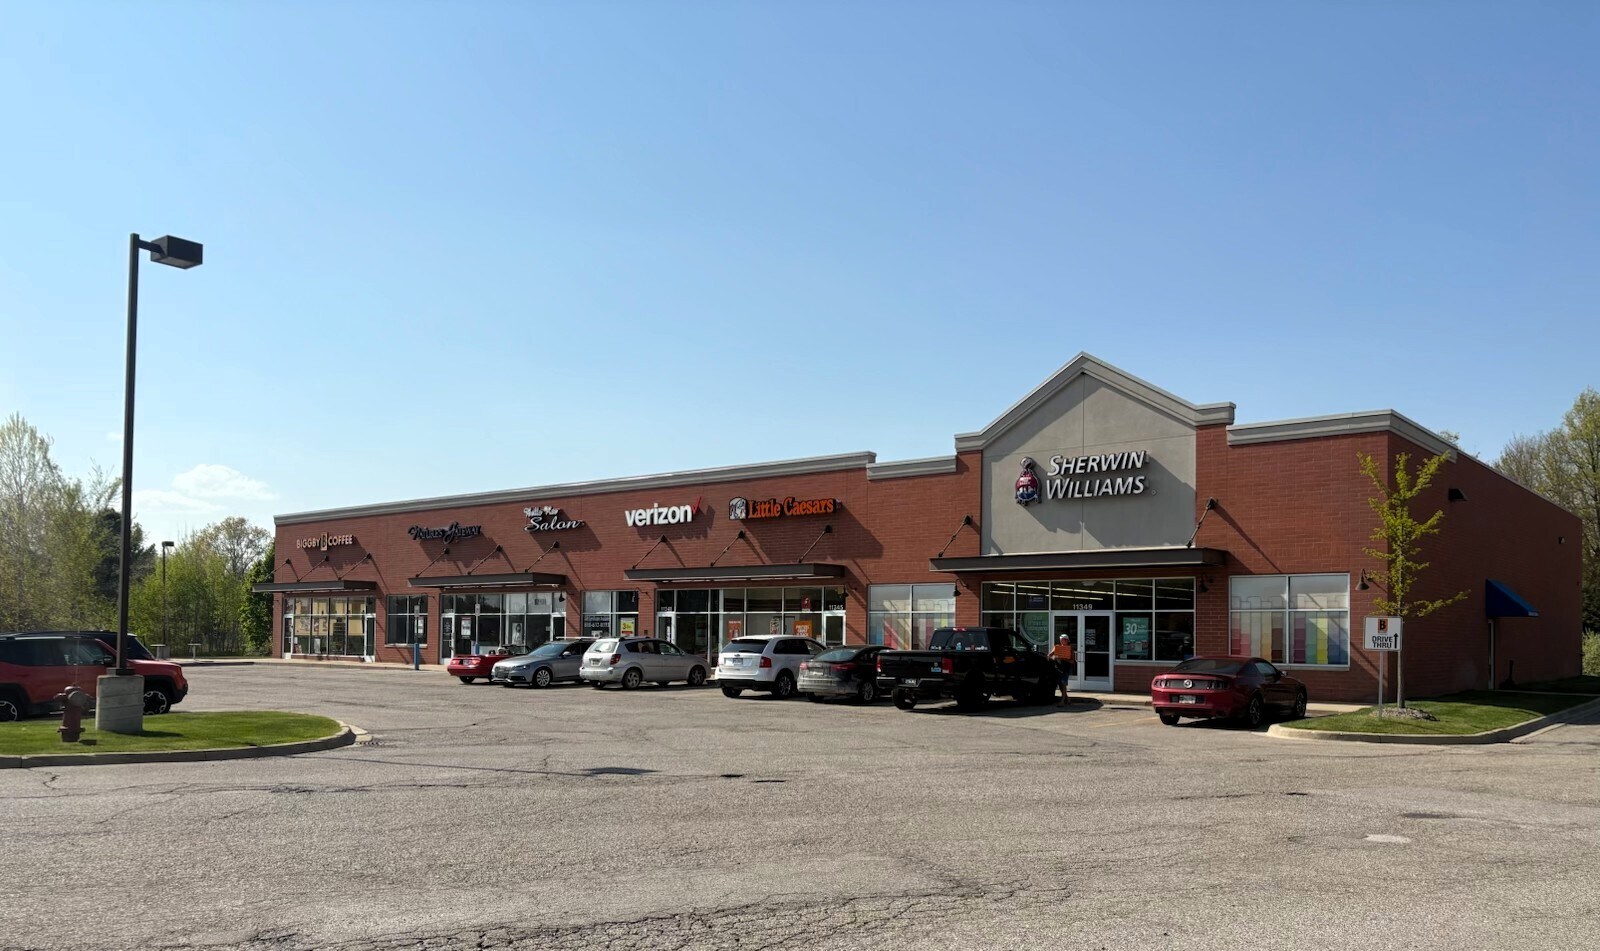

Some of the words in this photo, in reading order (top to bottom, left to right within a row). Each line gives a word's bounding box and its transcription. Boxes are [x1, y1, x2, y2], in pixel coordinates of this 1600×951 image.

[1047, 450, 1147, 476] SHERWIN
[1046, 475, 1146, 499] WILLIAMS
[624, 502, 692, 527] verizon
[747, 498, 780, 518] Little
[783, 496, 834, 515] Caesars
[524, 515, 582, 531] Salon
[296, 537, 320, 549] BIGGBY
[327, 534, 353, 546] COFFEE
[1379, 619, 1386, 630] B
